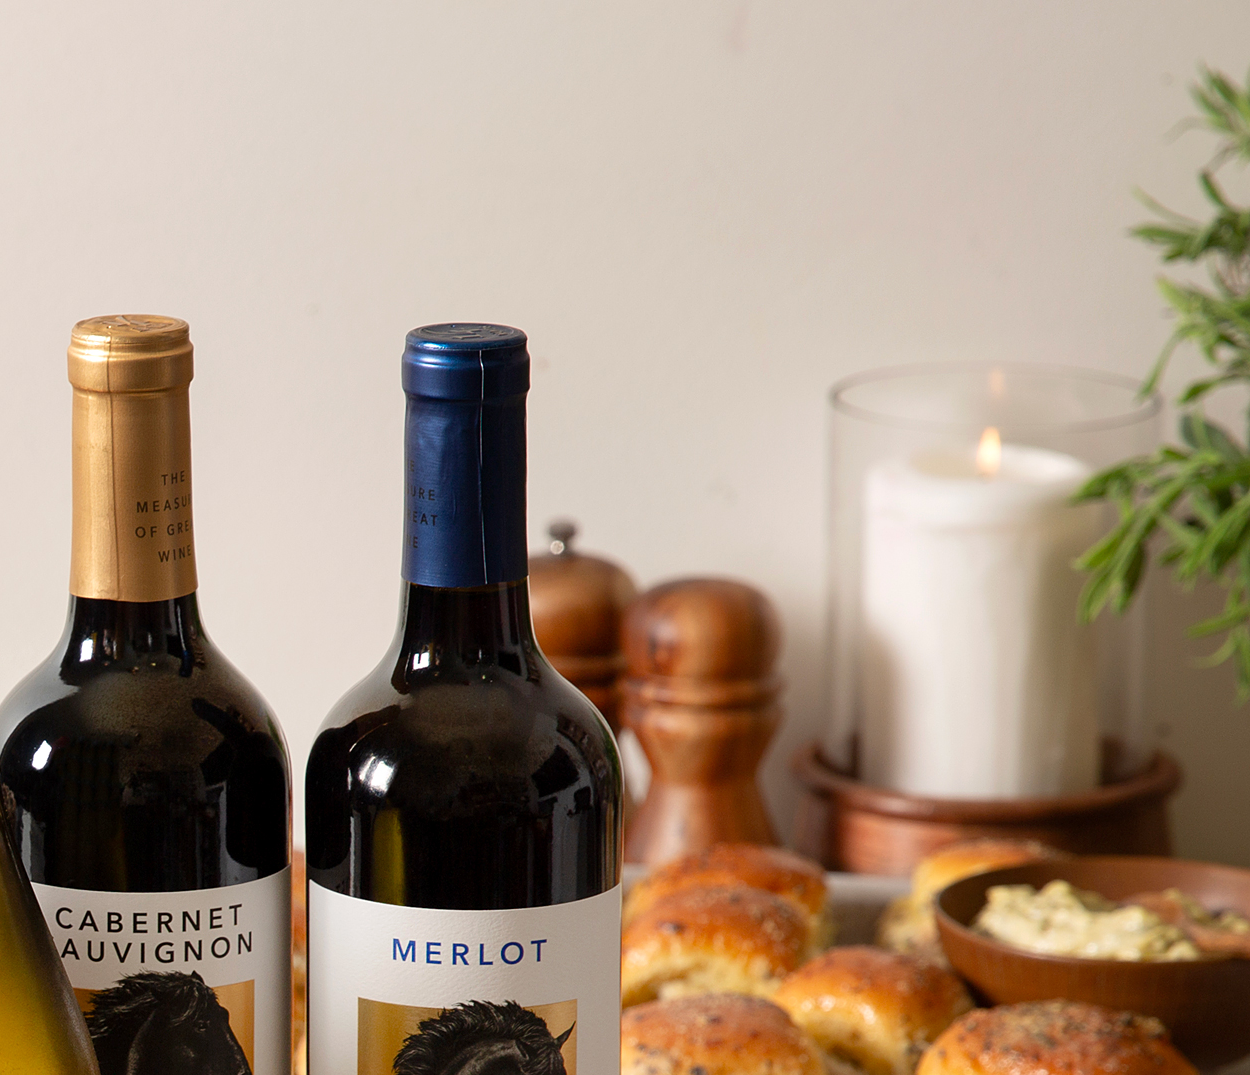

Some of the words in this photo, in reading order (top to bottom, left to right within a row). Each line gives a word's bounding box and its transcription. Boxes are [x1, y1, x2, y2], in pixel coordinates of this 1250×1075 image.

[161, 470, 185, 486] THE
[134, 526, 158, 538] OF
[166, 520, 192, 536] GRE
[157, 544, 192, 563] WINE
[55, 903, 243, 934] CABERNET
[60, 931, 252, 964] AUVIGNON
[391, 937, 549, 967] MERLOT
